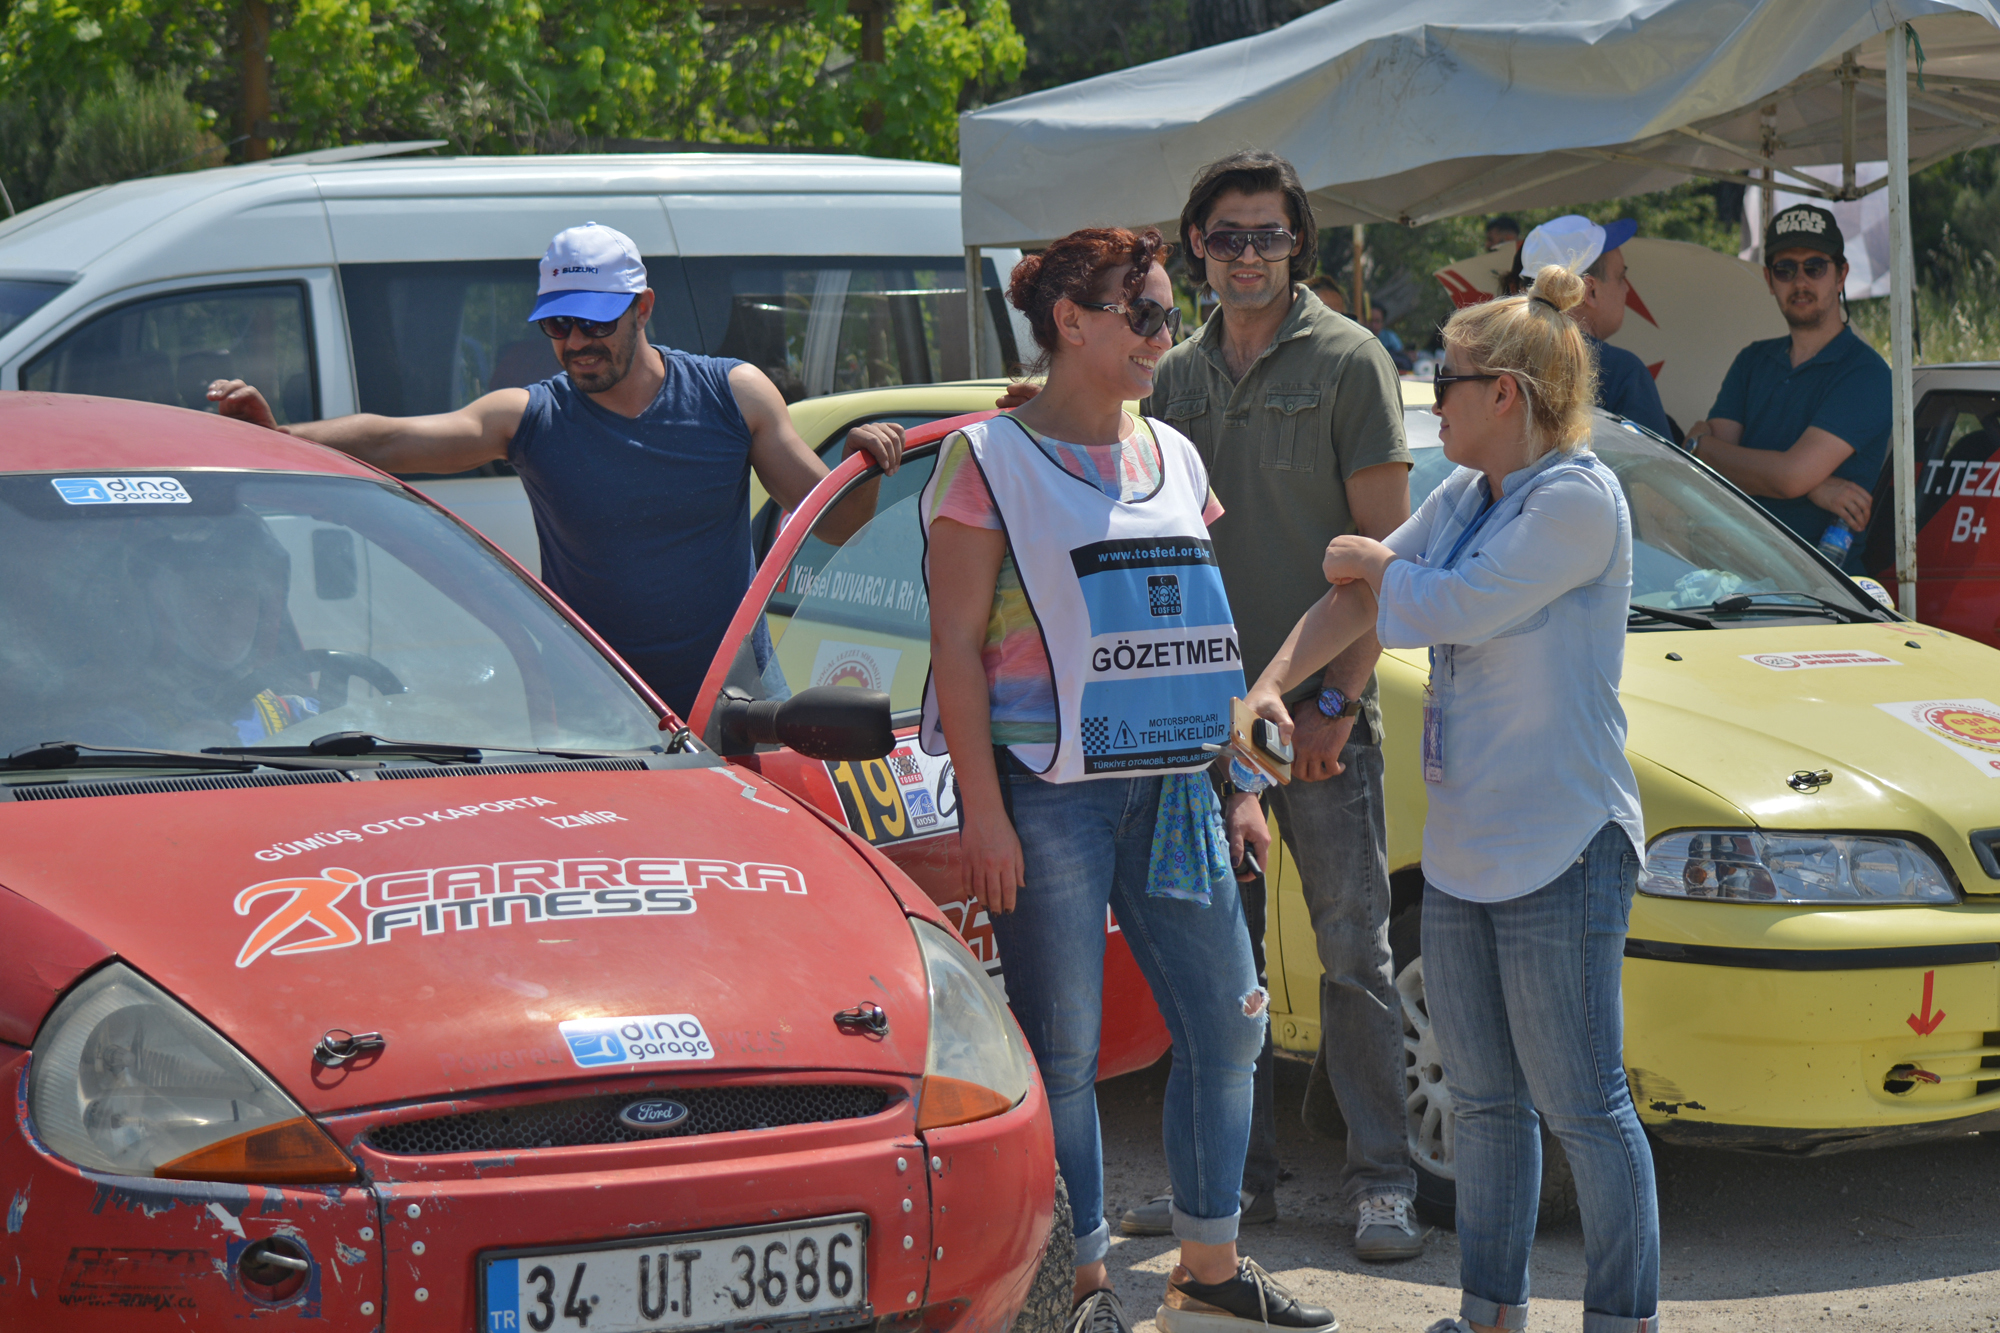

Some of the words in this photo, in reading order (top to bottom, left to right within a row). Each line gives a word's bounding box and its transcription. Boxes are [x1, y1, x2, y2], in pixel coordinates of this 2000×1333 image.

[1781, 210, 1823, 221] STAR
[1776, 219, 1826, 235] WARS
[562, 266, 599, 274] SUZUKI
[106, 478, 180, 492] dino
[113, 492, 187, 502] garage
[1951, 506, 1987, 543] B+
[791, 564, 832, 598] Yüksel
[830, 571, 886, 606] DUVARCI
[884, 579, 896, 609] A
[896, 580, 915, 611] Rh
[1152, 606, 1181, 615] TOSFED
[1092, 637, 1241, 672] GÖZETMEN
[1149, 713, 1218, 728] MOTORSPORLARI
[1139, 722, 1225, 744] TEHLİKELİDİR
[1093, 760, 1126, 769] TÜRKİYE
[1128, 756, 1165, 767] OTOMOBİL
[1167, 754, 1200, 764] SPORLARI
[899, 773, 923, 784] TOSFED
[834, 758, 905, 841] 19
[255, 828, 364, 862] GÜMÜŞ
[361, 816, 426, 835] OTO
[423, 796, 558, 822] KAPORTA
[540, 809, 629, 829] İZMİR
[361, 858, 808, 909] CARRERA
[367, 888, 697, 944] FITNESS
[621, 1019, 701, 1042] dino
[630, 1039, 710, 1060] garage
[638, 1102, 674, 1120] Ford
[526, 1262, 593, 1333] 34
[731, 1233, 854, 1309] 3686
[490, 1310, 516, 1329] TR
